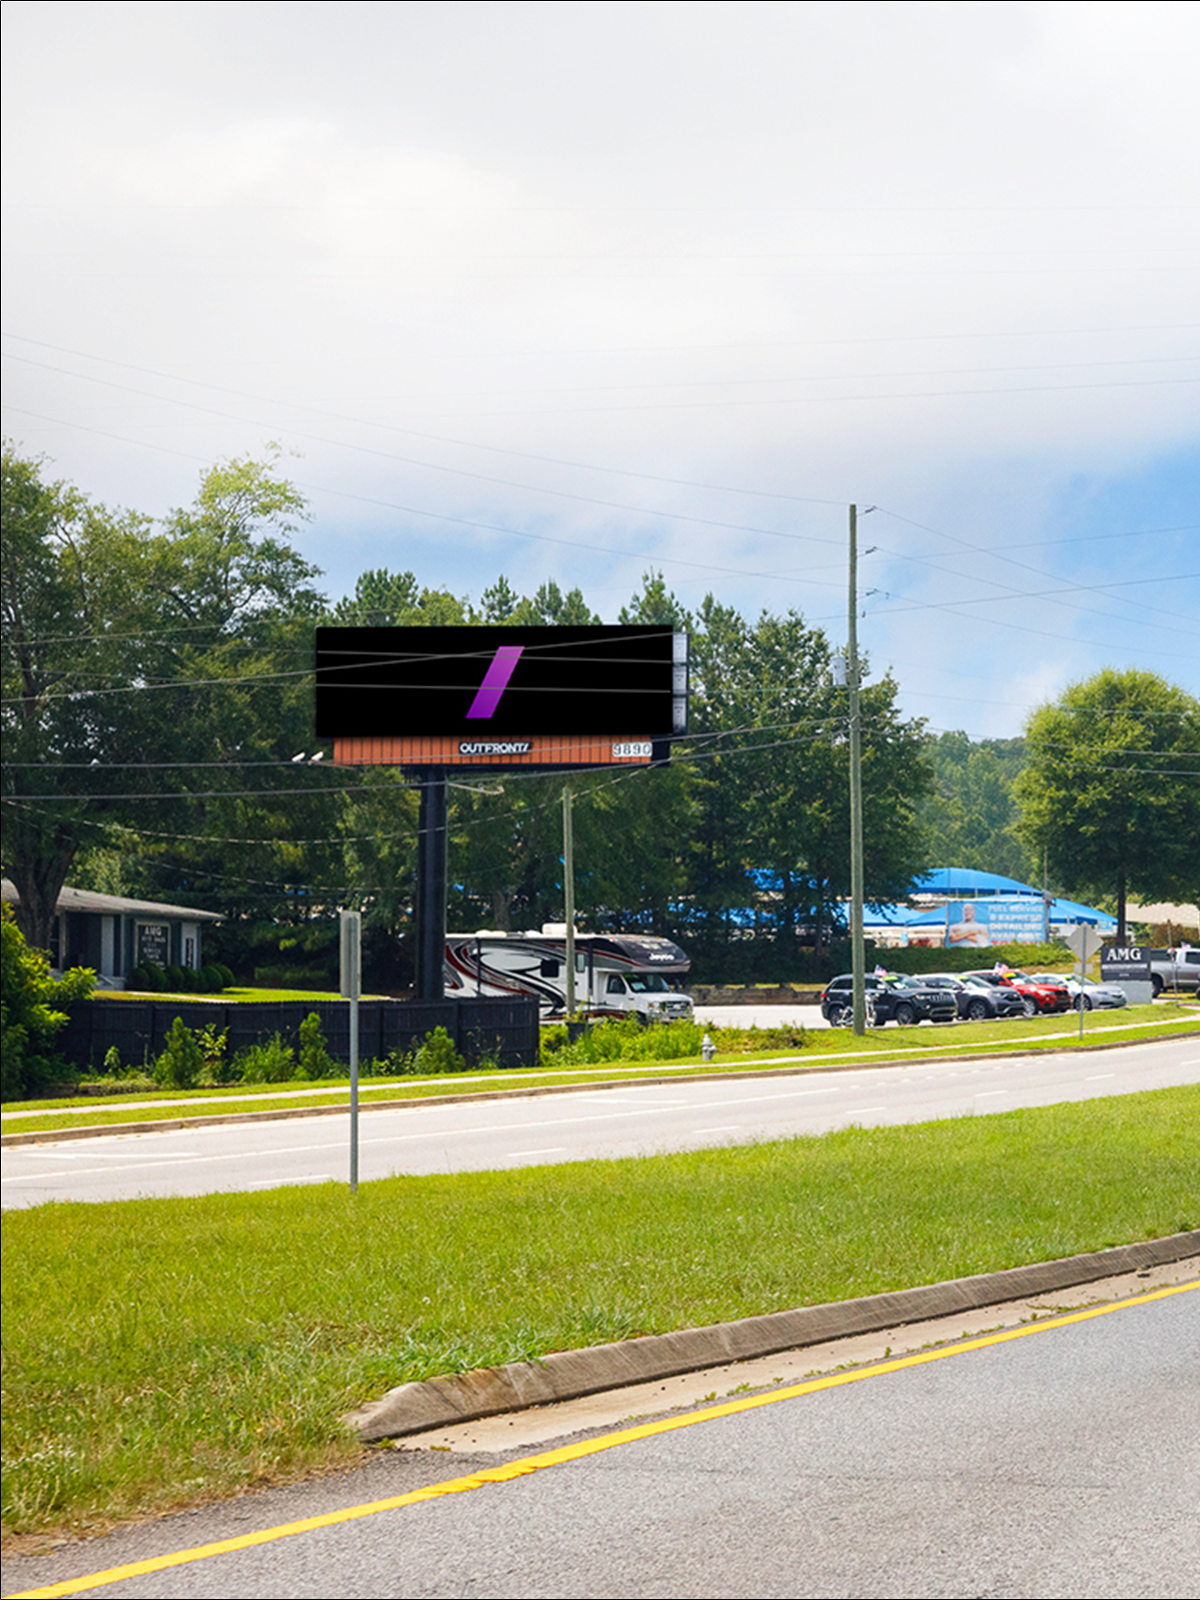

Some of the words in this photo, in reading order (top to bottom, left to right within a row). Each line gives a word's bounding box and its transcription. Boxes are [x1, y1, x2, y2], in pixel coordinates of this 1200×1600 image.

[613, 743, 651, 756] 9890
[988, 904, 1007, 912] FULL
[1009, 904, 1044, 912] SERVICE
[1106, 947, 1142, 961] AMG
